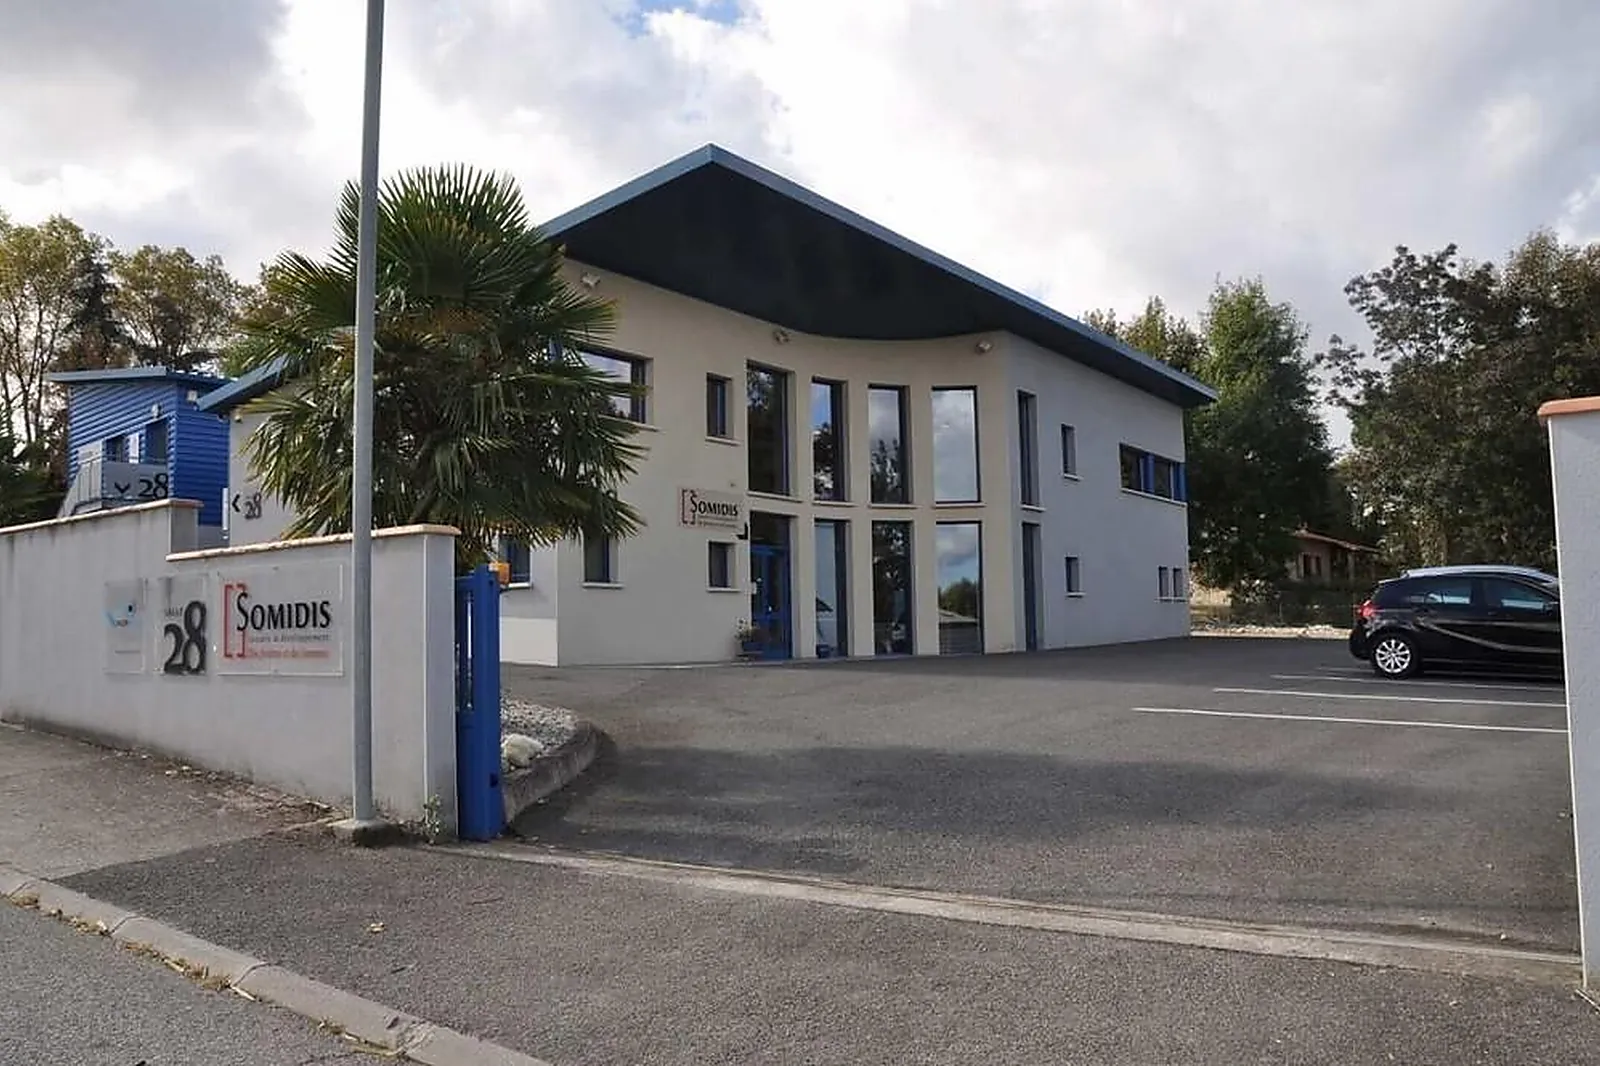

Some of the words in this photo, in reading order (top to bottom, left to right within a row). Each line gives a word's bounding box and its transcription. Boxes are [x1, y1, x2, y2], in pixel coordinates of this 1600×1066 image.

[138, 473, 169, 499] 28
[244, 493, 262, 519] 28
[163, 600, 208, 674] 28
